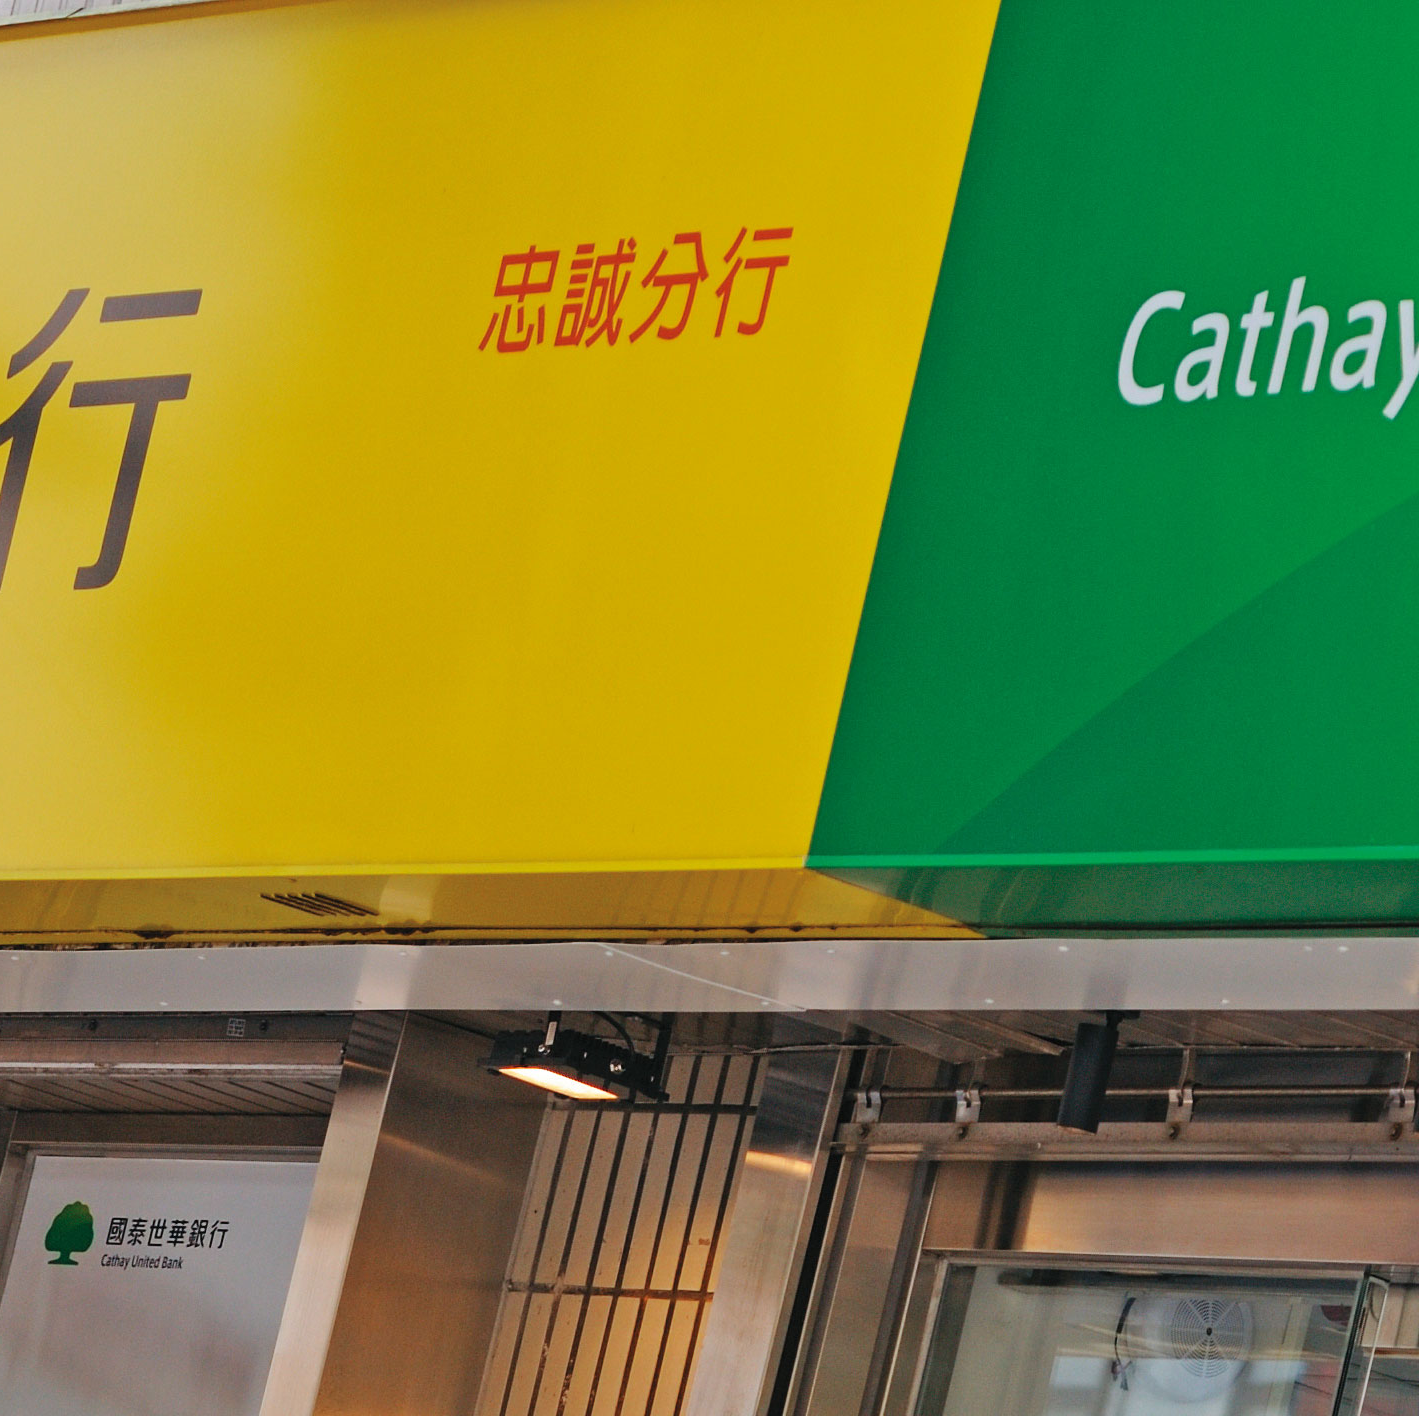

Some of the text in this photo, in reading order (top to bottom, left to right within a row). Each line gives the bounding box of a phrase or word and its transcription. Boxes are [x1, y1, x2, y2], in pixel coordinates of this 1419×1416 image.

[479, 227, 795, 354] 忠誠分行
[1117, 275, 1419, 420] Cathay
[101, 1253, 183, 1270] Cathay United Bank
[105, 1217, 230, 1249] 國泰世華銀行
